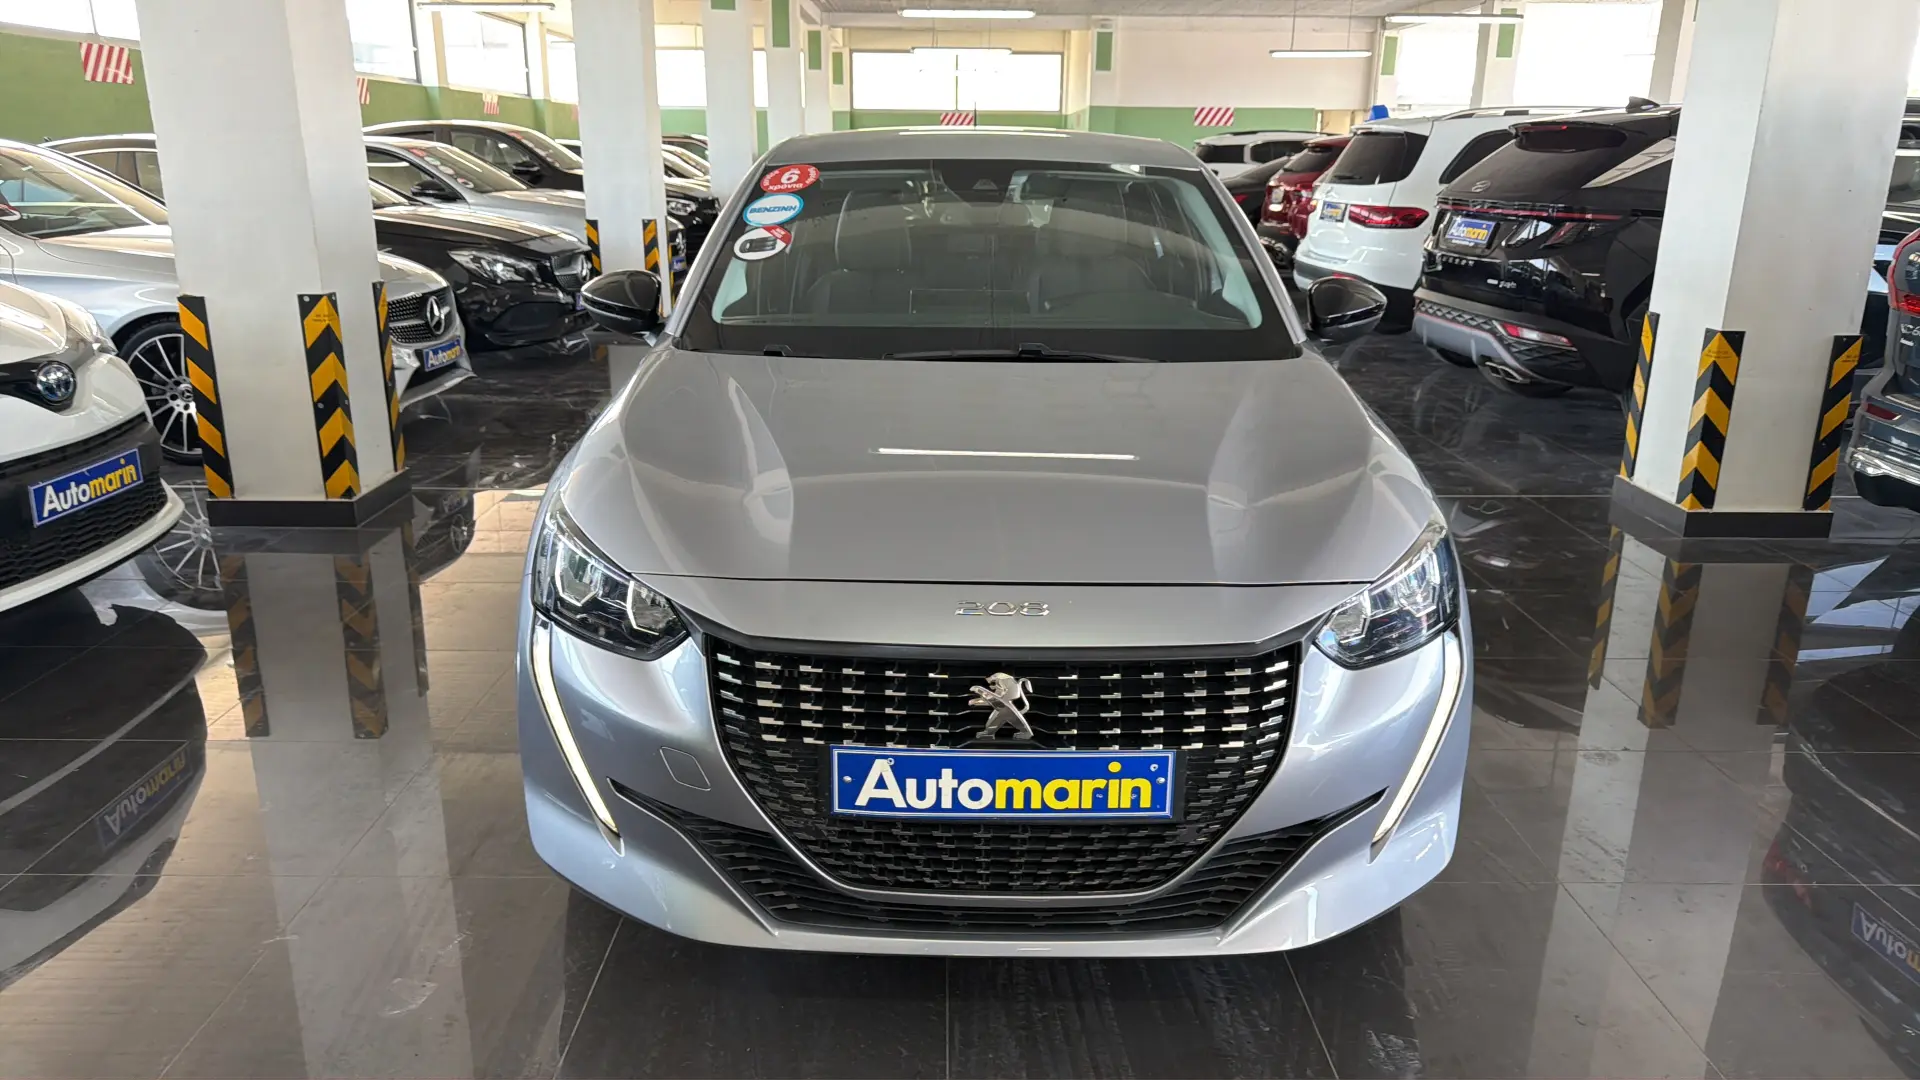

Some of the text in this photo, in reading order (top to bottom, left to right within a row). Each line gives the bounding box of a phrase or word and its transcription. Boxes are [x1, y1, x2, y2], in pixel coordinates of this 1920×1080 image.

[780, 169, 801, 184] 6
[42, 457, 138, 518] Automarin
[953, 600, 1050, 617] 208
[853, 758, 1152, 810] Automarin
